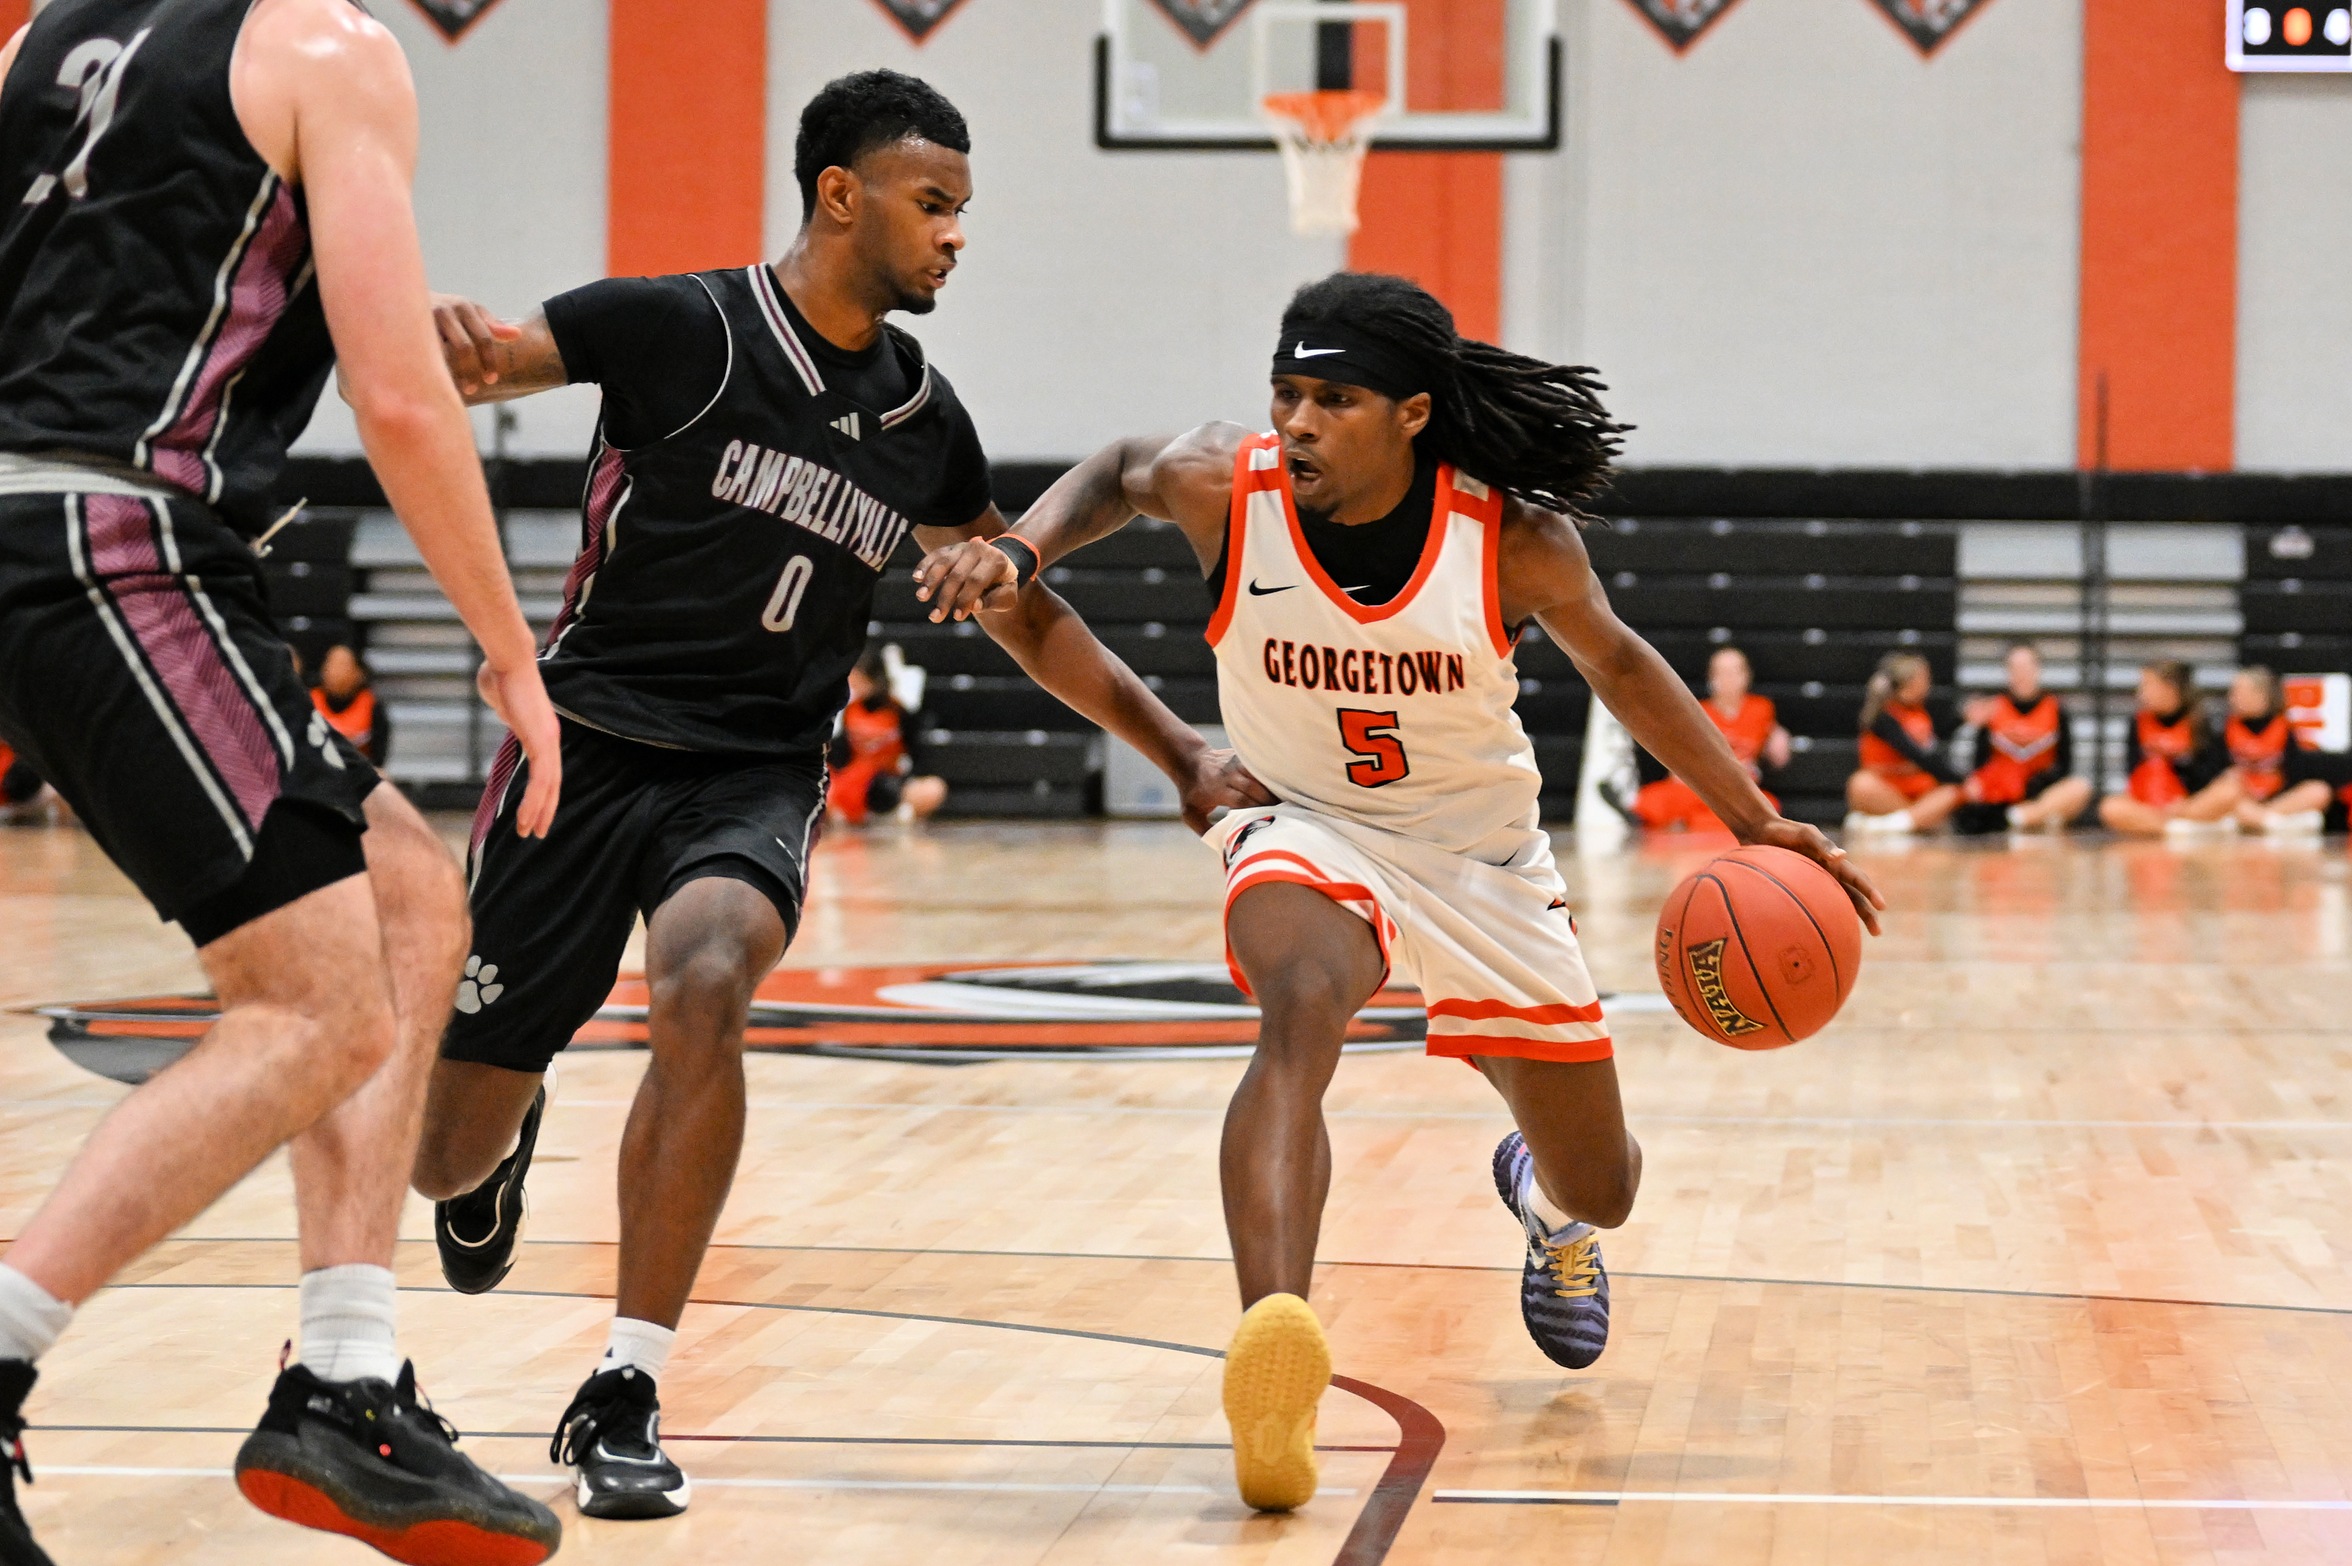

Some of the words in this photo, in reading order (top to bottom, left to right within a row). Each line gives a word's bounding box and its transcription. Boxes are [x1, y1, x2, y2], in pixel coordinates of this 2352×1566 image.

[761, 554, 814, 632] 0
[1263, 637, 1465, 697] GEORGETOWN
[1336, 707, 1411, 789] 5
[1687, 939, 1757, 1036] NAIA
